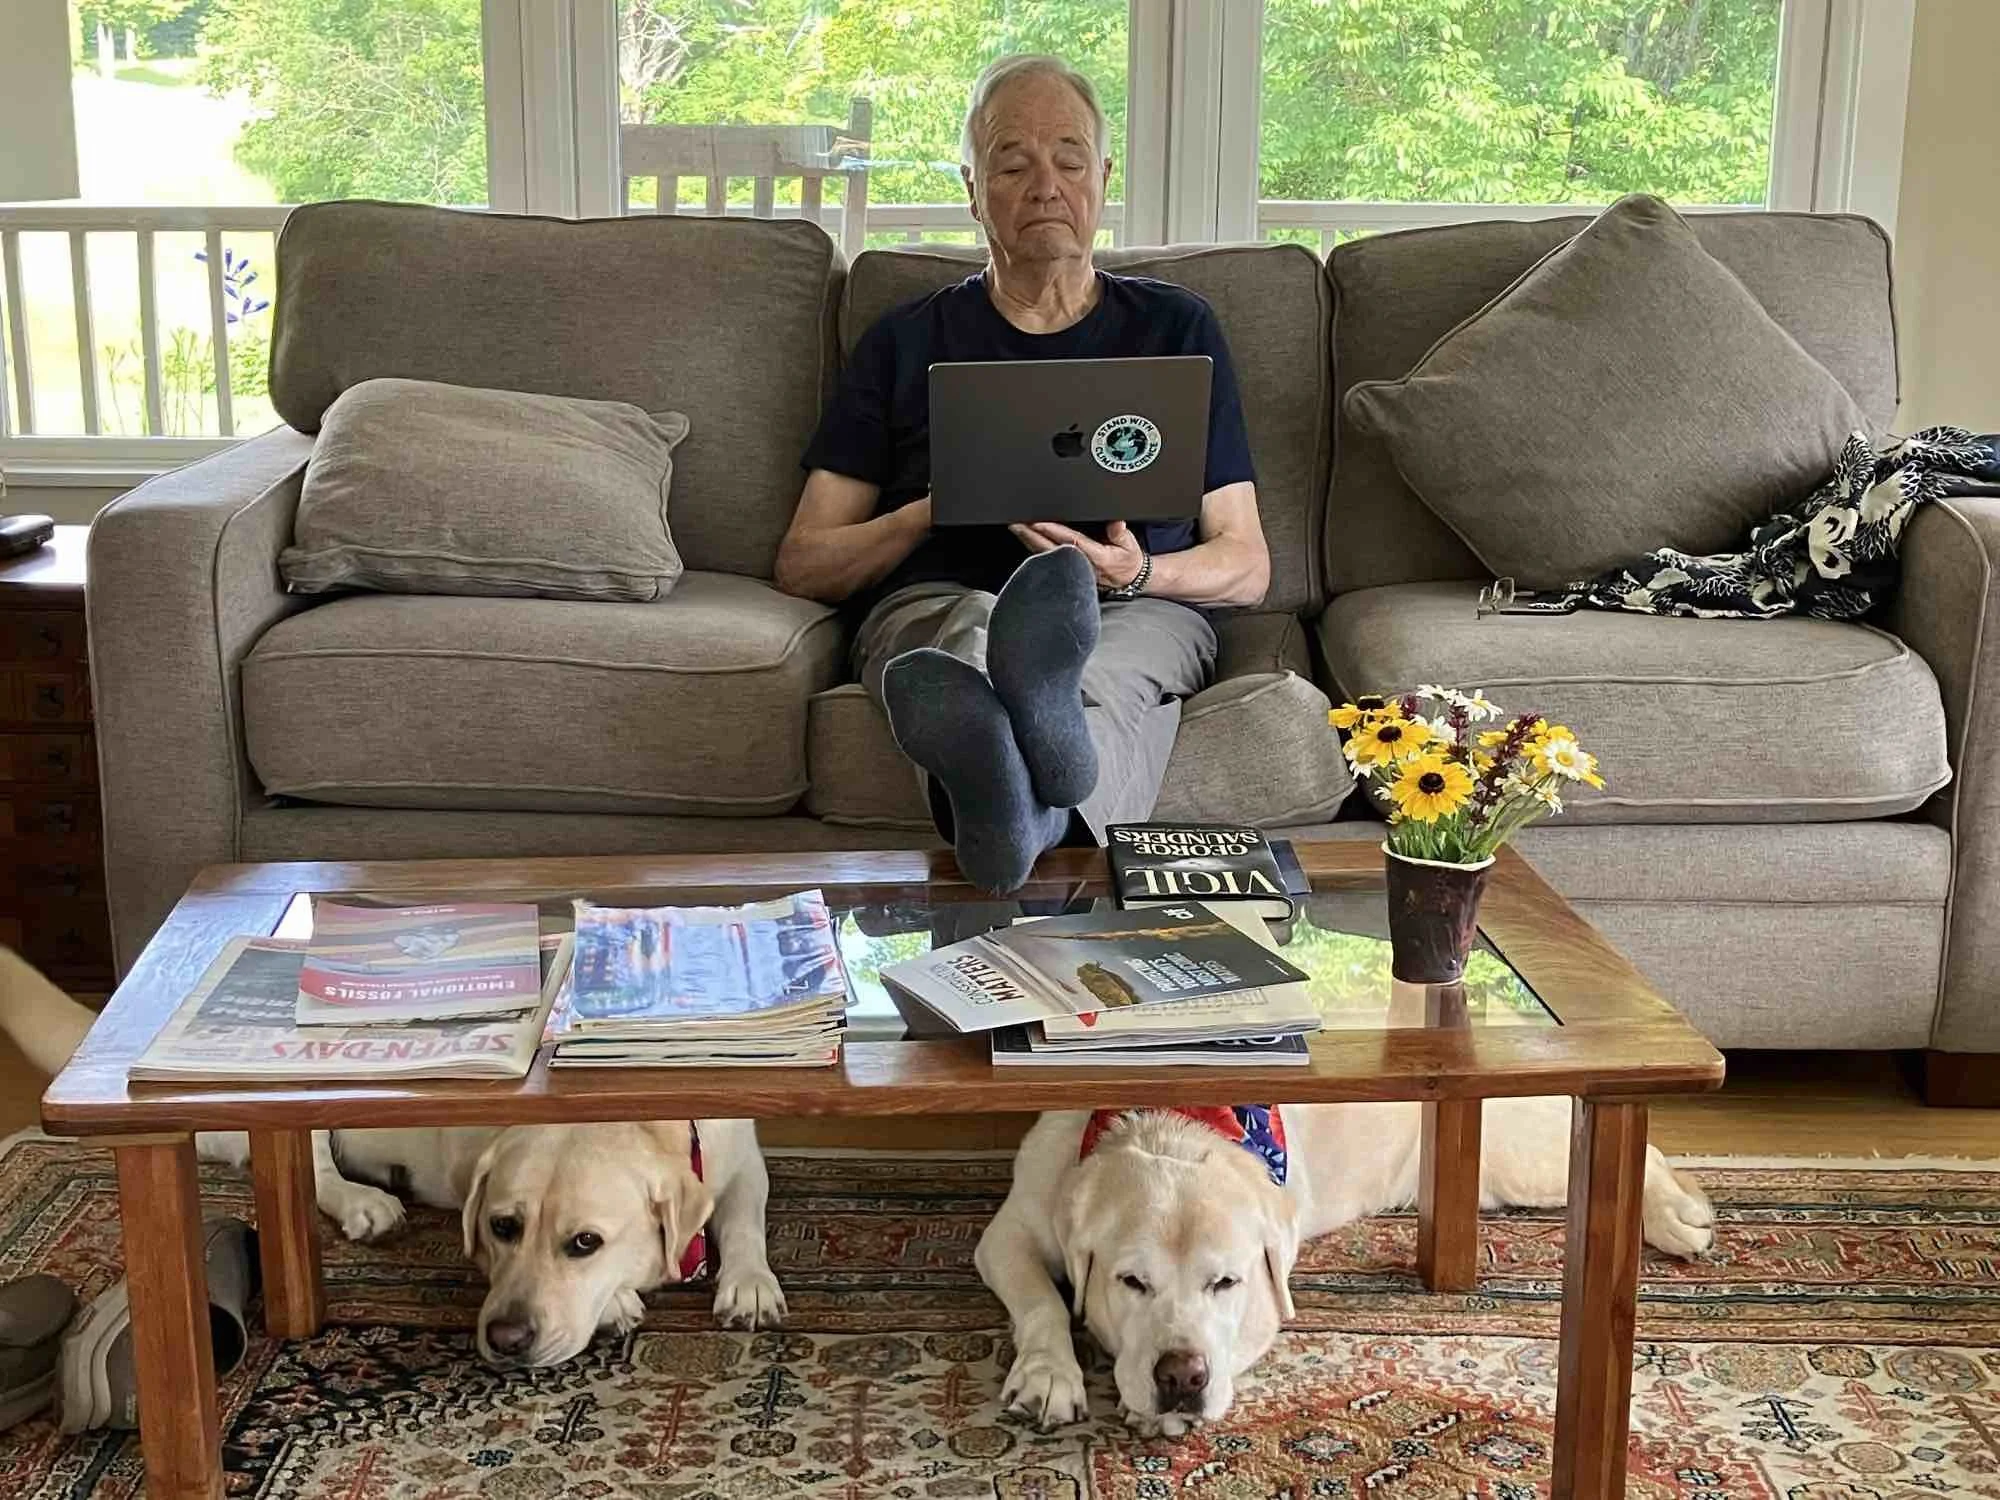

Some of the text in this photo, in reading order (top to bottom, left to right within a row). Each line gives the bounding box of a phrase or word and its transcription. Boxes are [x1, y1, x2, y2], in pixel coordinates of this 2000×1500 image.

[1098, 417, 1154, 438] STAND WITH
[1095, 442, 1158, 470] CLIMATE SCIENCE
[1113, 830, 1260, 844] SAUNDERS
[1134, 842, 1248, 856] GEORGE
[1125, 869, 1281, 894] VIGIL
[946, 955, 1025, 1002] MATTERS
[323, 985, 403, 1000] FOSSILS
[407, 980, 516, 997] EMOTIONAL
